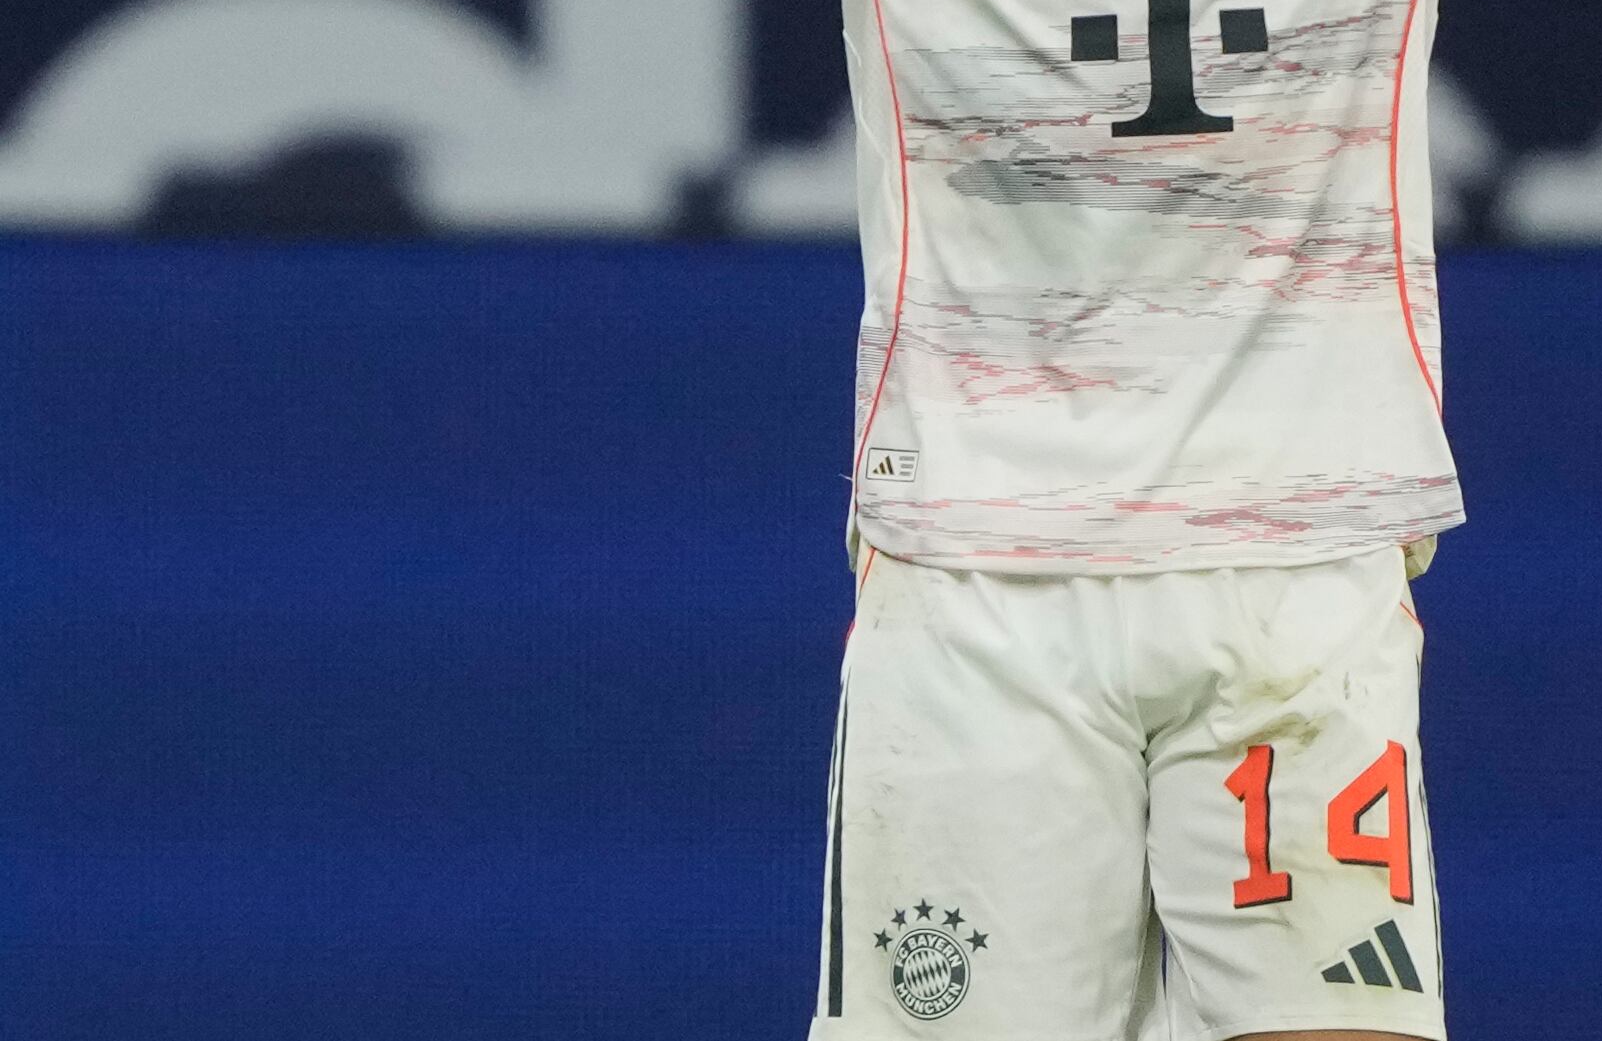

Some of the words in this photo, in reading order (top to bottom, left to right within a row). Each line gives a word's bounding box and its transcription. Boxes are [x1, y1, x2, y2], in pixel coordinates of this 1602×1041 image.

[1223, 739, 1415, 910] 14
[895, 947, 909, 968] FC
[907, 934, 962, 968] BAYERN
